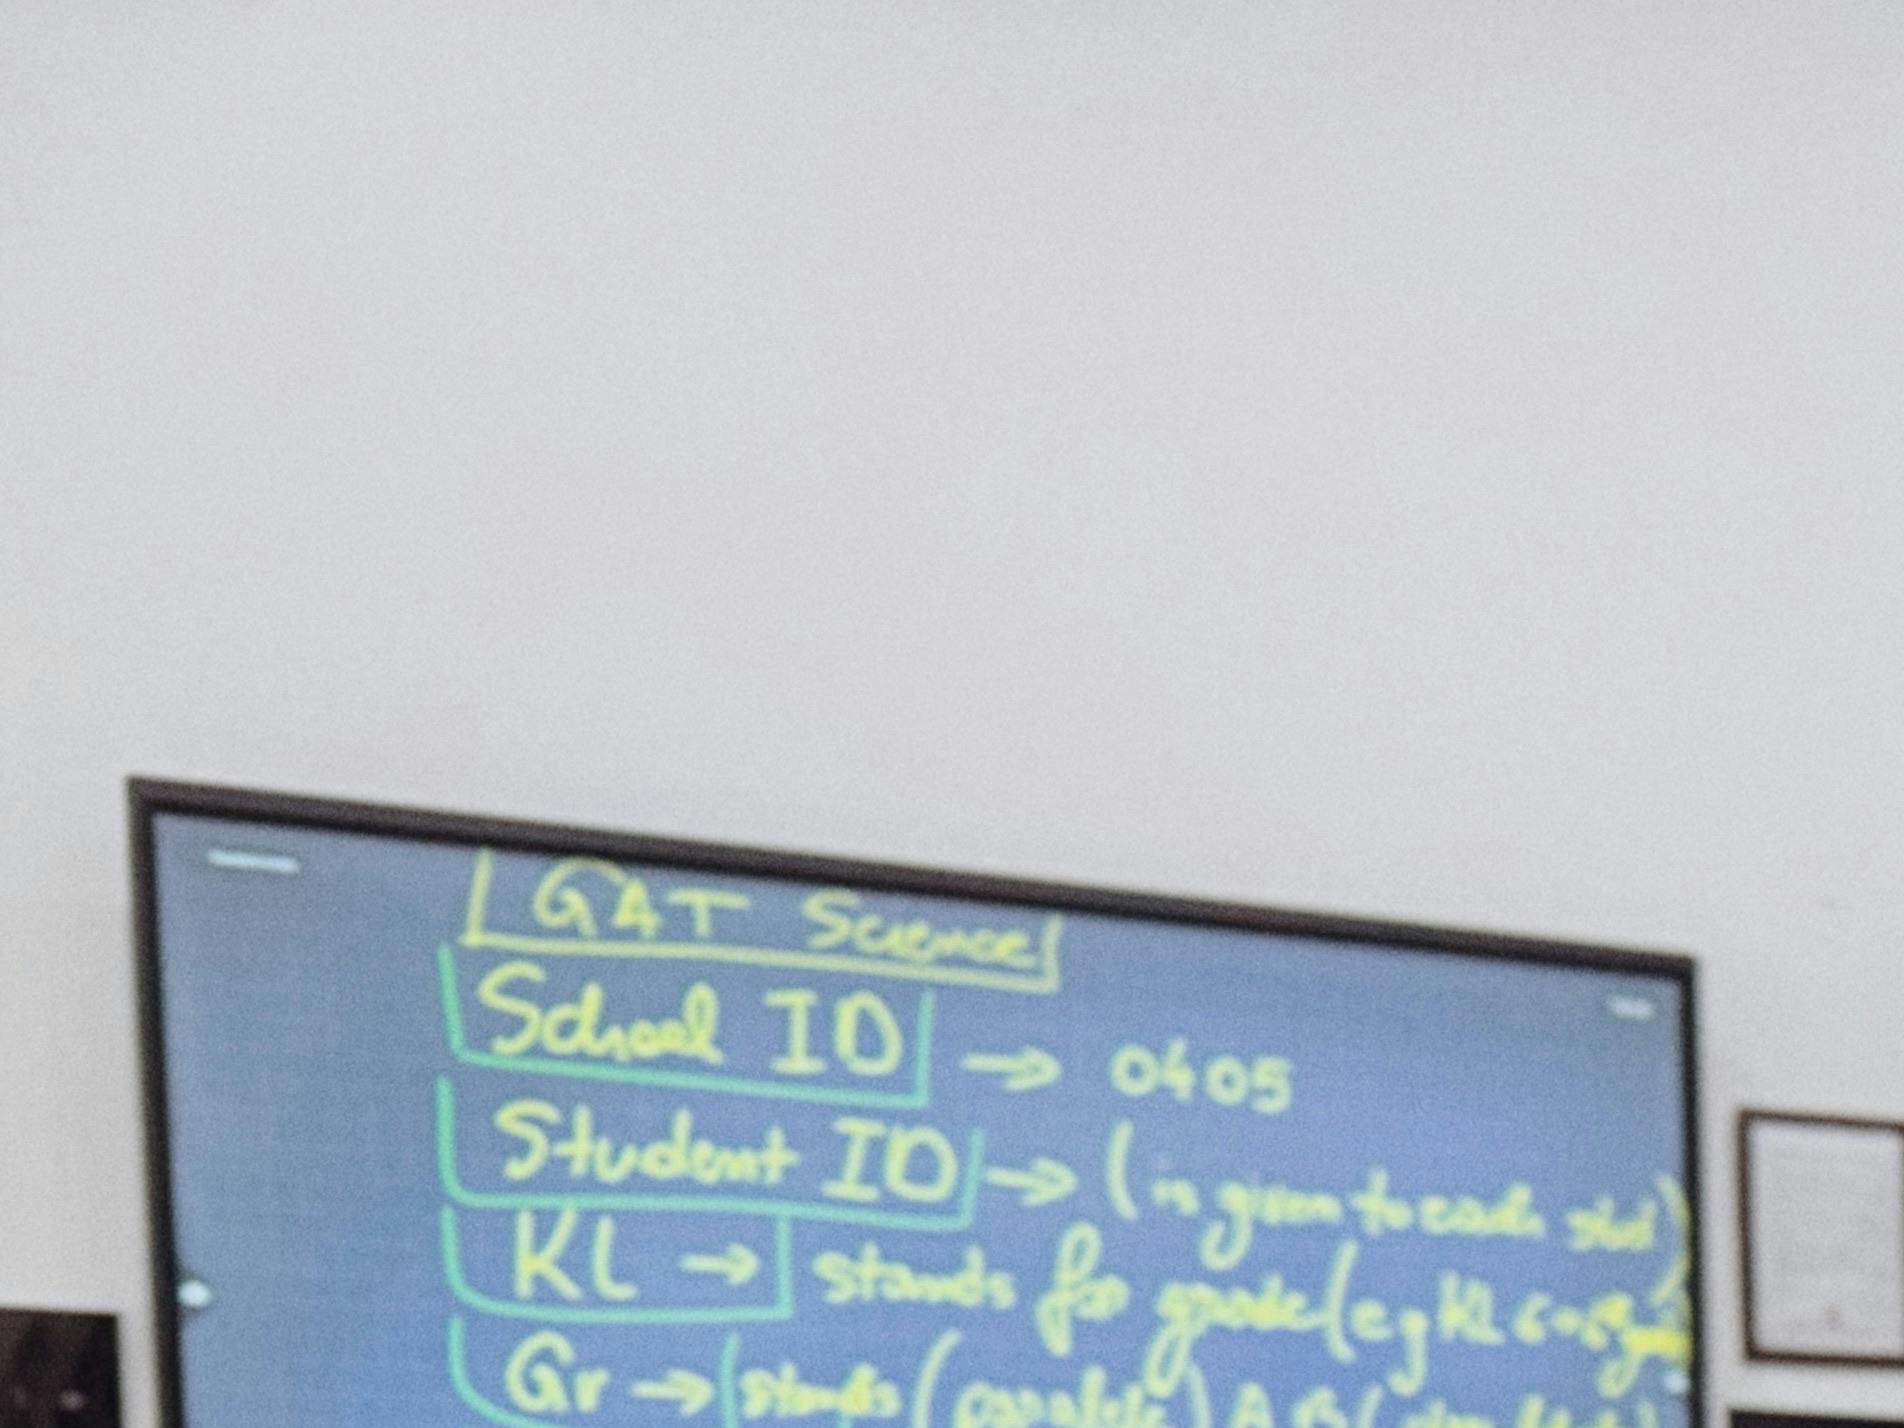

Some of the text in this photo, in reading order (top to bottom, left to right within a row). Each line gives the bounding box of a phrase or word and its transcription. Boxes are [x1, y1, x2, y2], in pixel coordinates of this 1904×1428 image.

[803, 888, 1038, 969] Science
[476, 959, 1293, 1114] School ID 0405
[494, 1098, 800, 1181] Student
[823, 1116, 959, 1202] ID
[512, 1207, 639, 1302] KL
[812, 1240, 1015, 1311] stands
[504, 1331, 609, 1412] Gr
